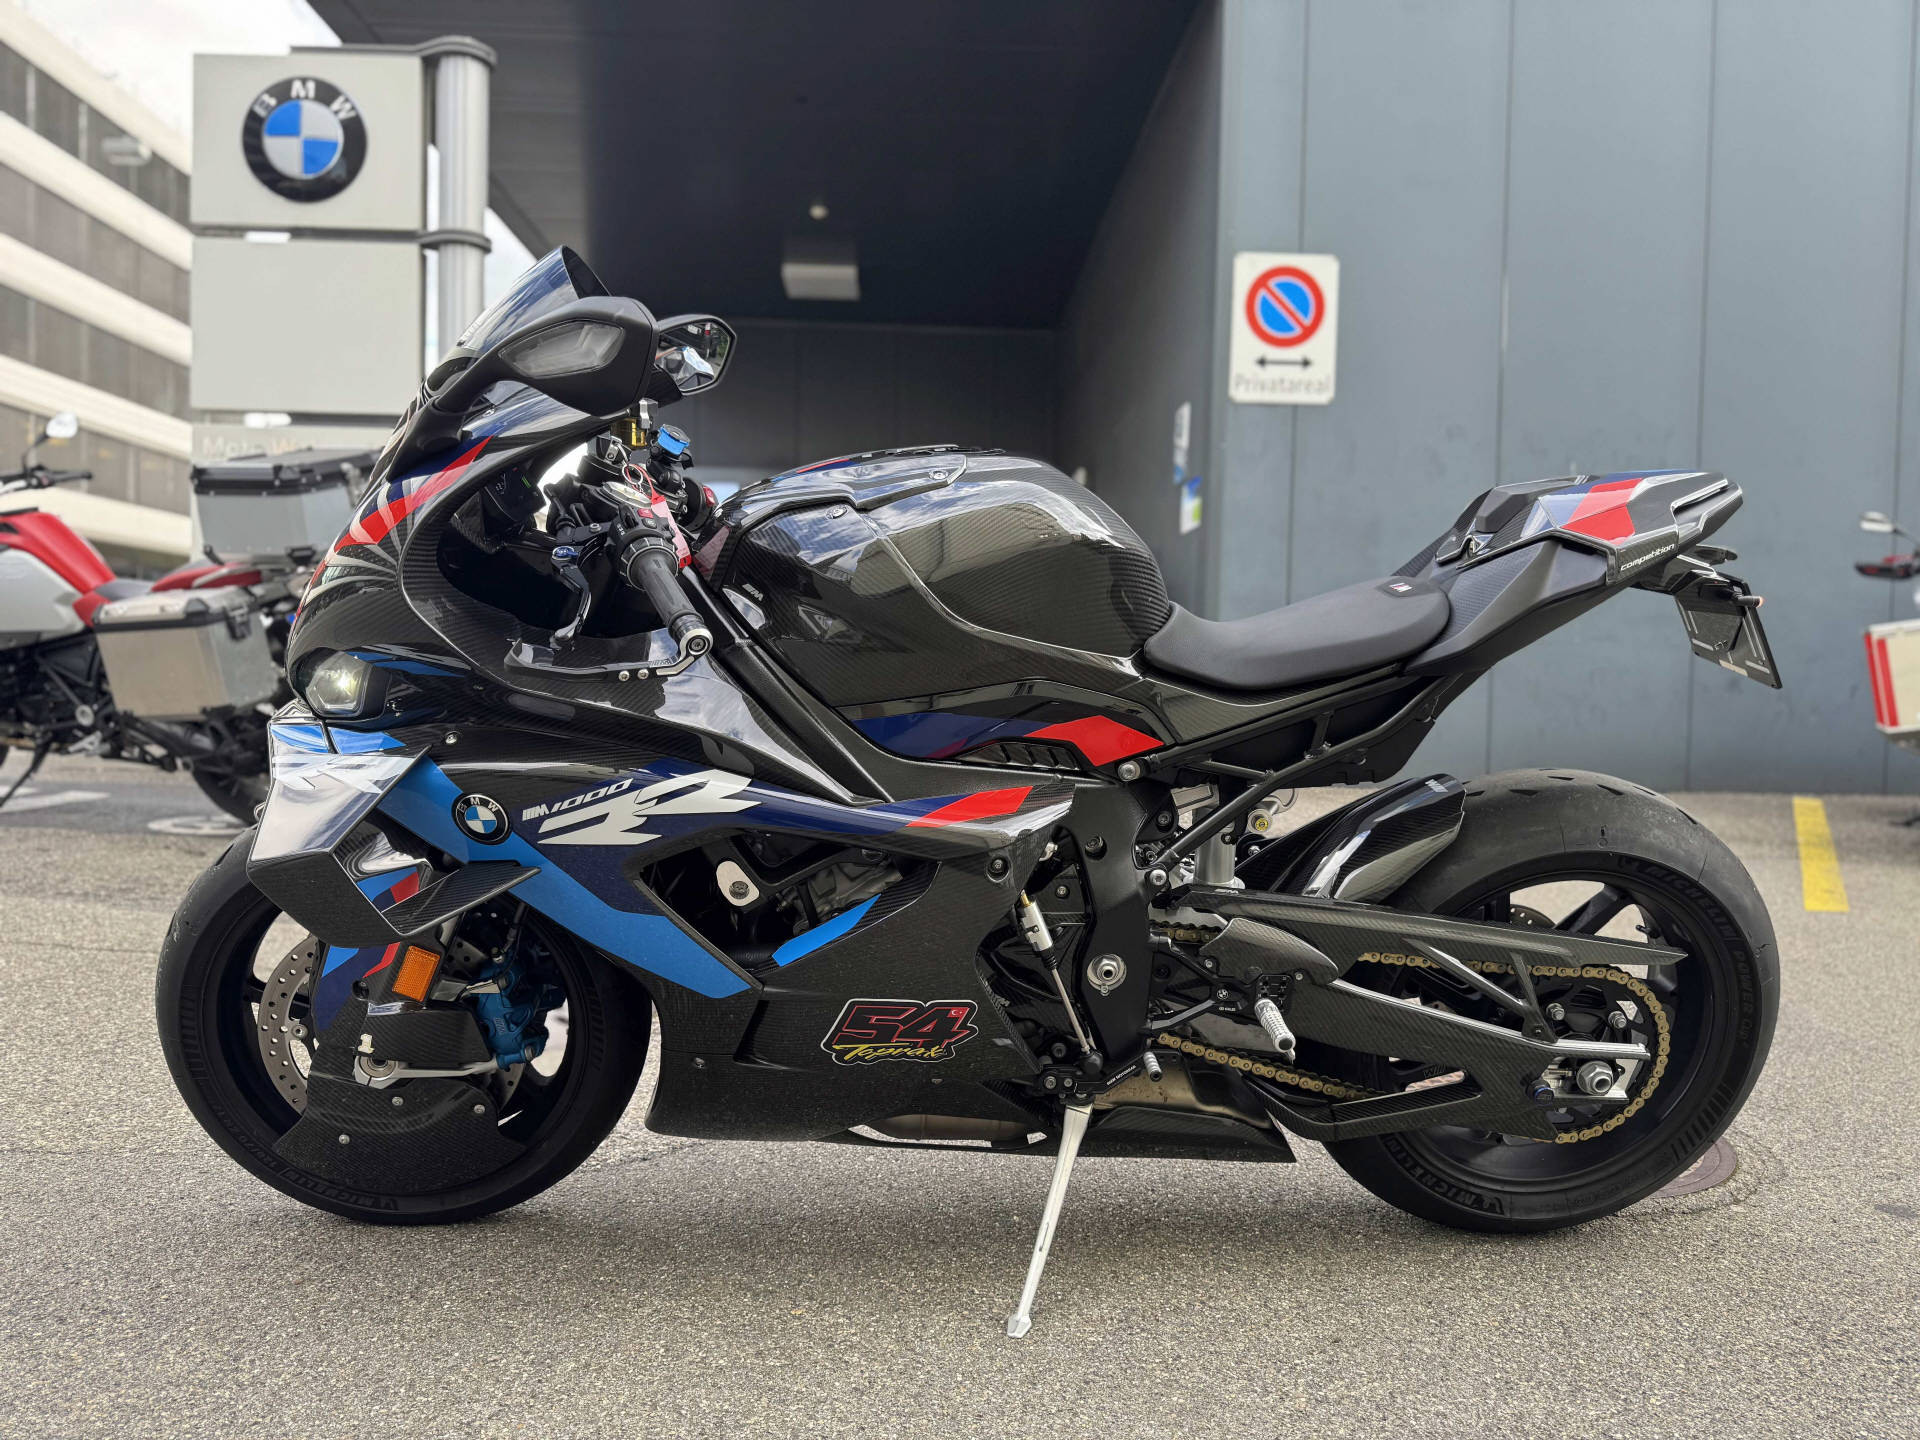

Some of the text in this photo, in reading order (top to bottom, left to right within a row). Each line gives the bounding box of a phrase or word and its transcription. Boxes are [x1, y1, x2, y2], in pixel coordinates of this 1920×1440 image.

[253, 79, 357, 119] BMW
[1234, 373, 1331, 394] Privatareal
[1620, 543, 1675, 571] competition
[832, 1005, 972, 1048] 54
[832, 1042, 948, 1061] Toprak
